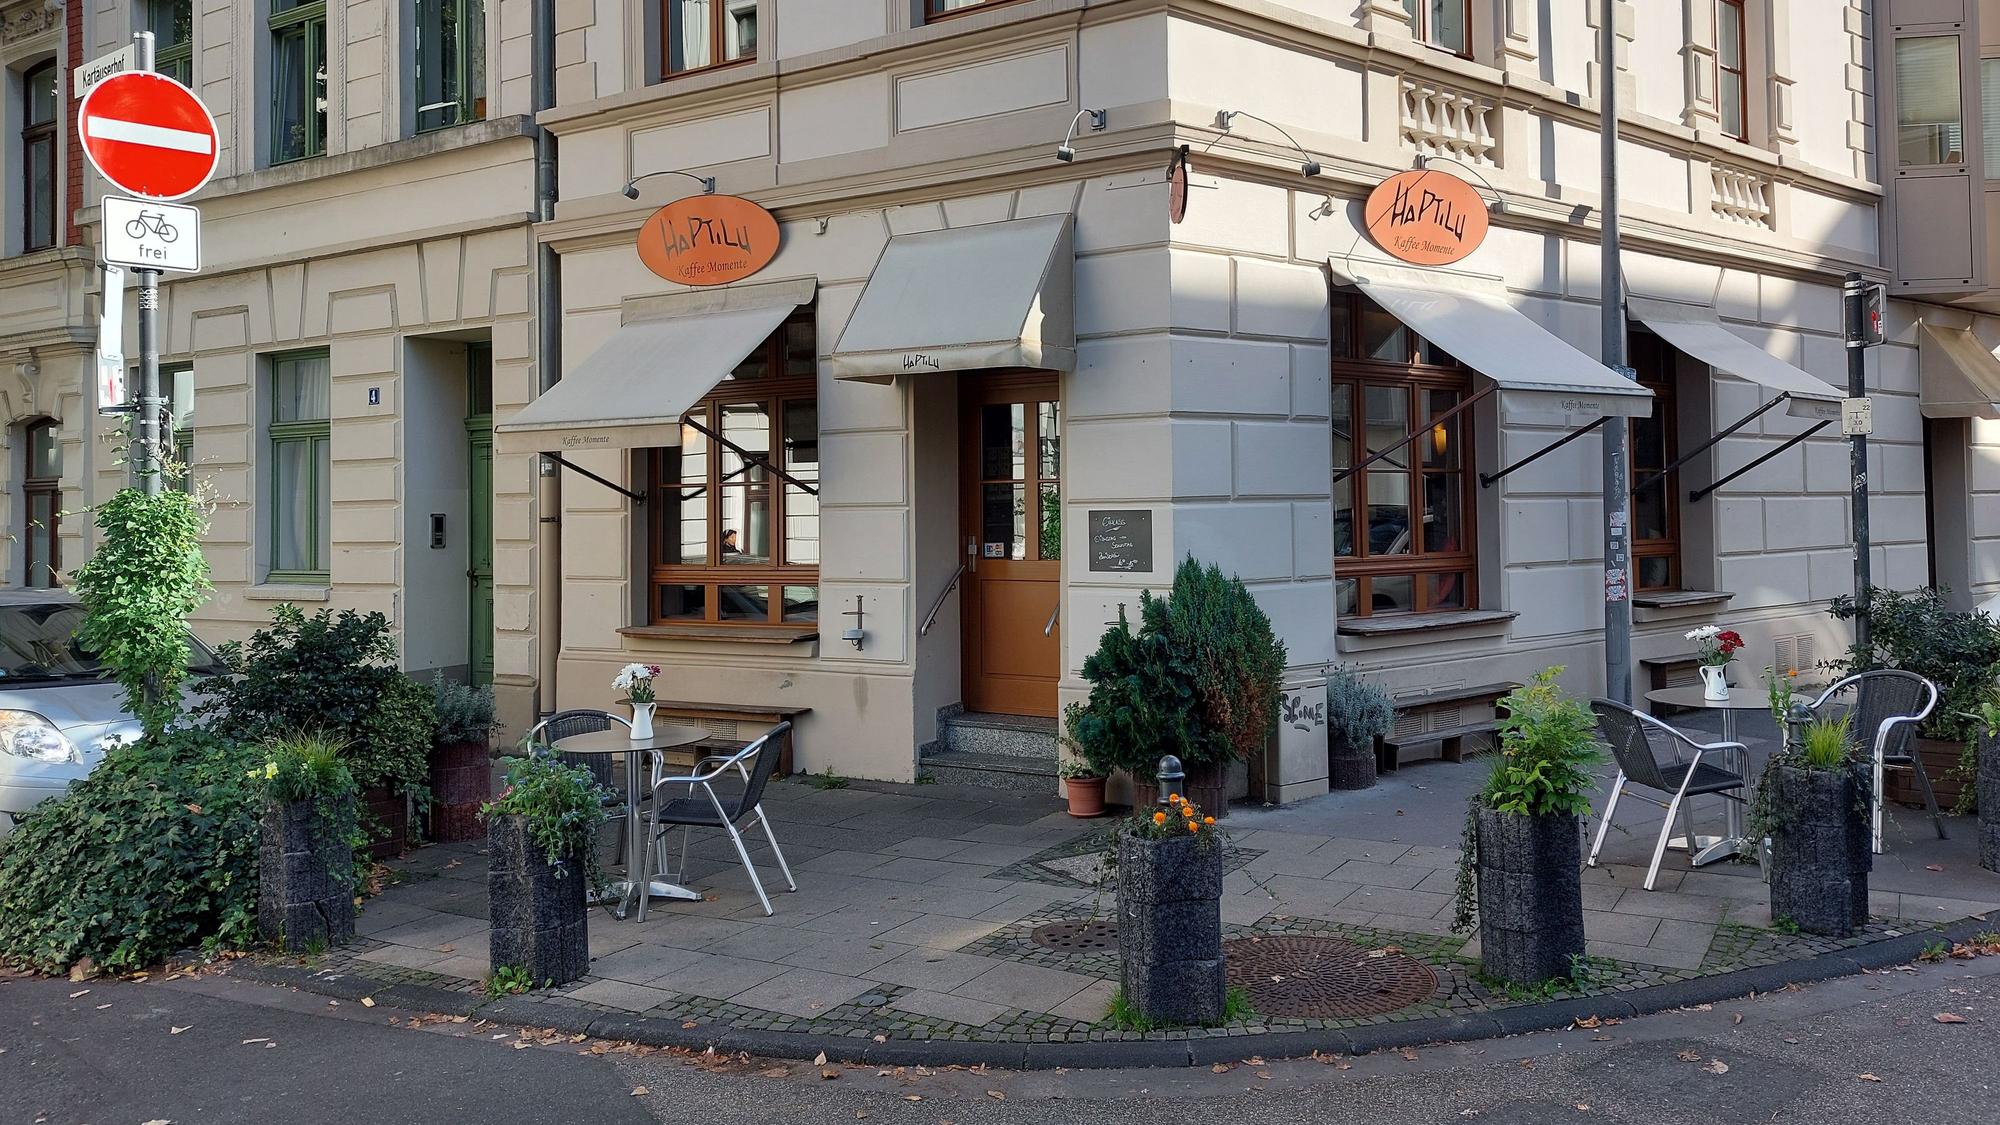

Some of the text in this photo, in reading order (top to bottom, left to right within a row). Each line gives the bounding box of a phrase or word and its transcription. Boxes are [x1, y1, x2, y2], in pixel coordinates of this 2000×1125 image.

[139, 244, 167, 260] frei
[1394, 236, 1455, 255] Kaffee Momente
[678, 260, 749, 279] Kaffee Momente
